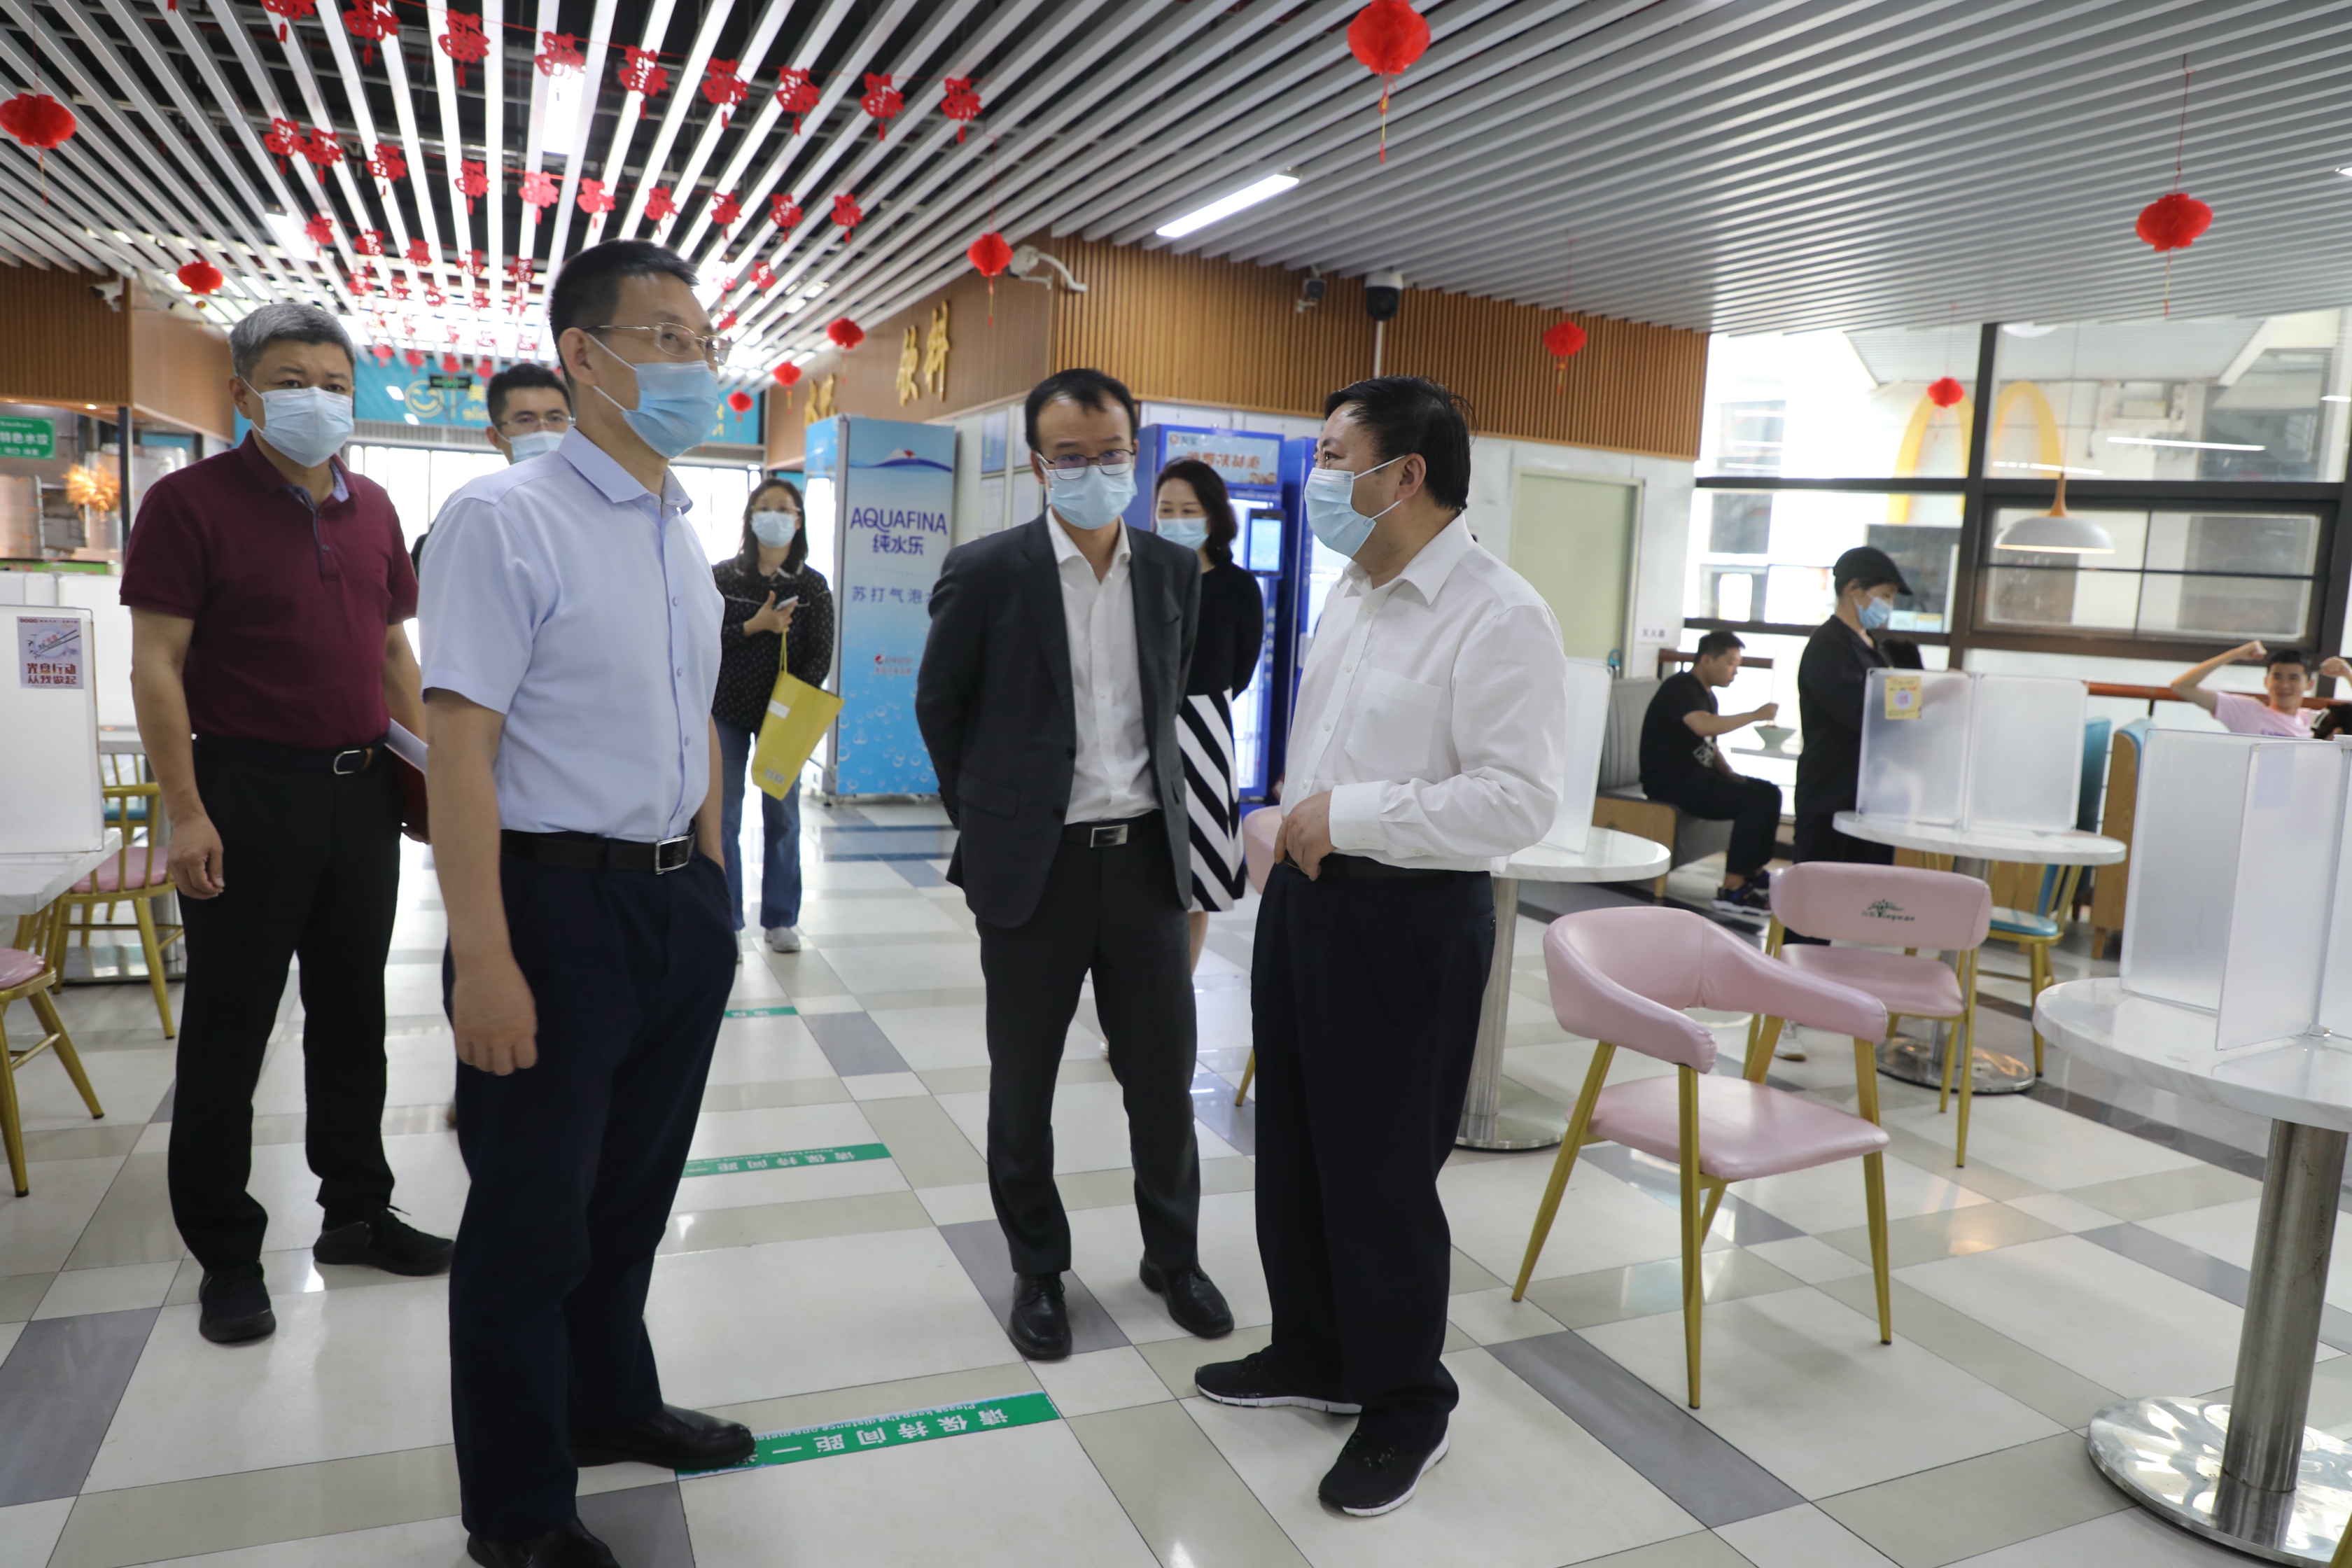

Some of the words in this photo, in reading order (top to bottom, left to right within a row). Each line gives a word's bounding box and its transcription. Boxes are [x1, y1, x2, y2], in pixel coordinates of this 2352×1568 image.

[849, 507, 948, 536] AQUAFINA
[872, 533, 924, 555] 纯水乐
[27, 662, 76, 675] 光盘行动
[27, 675, 76, 685] 从我做起
